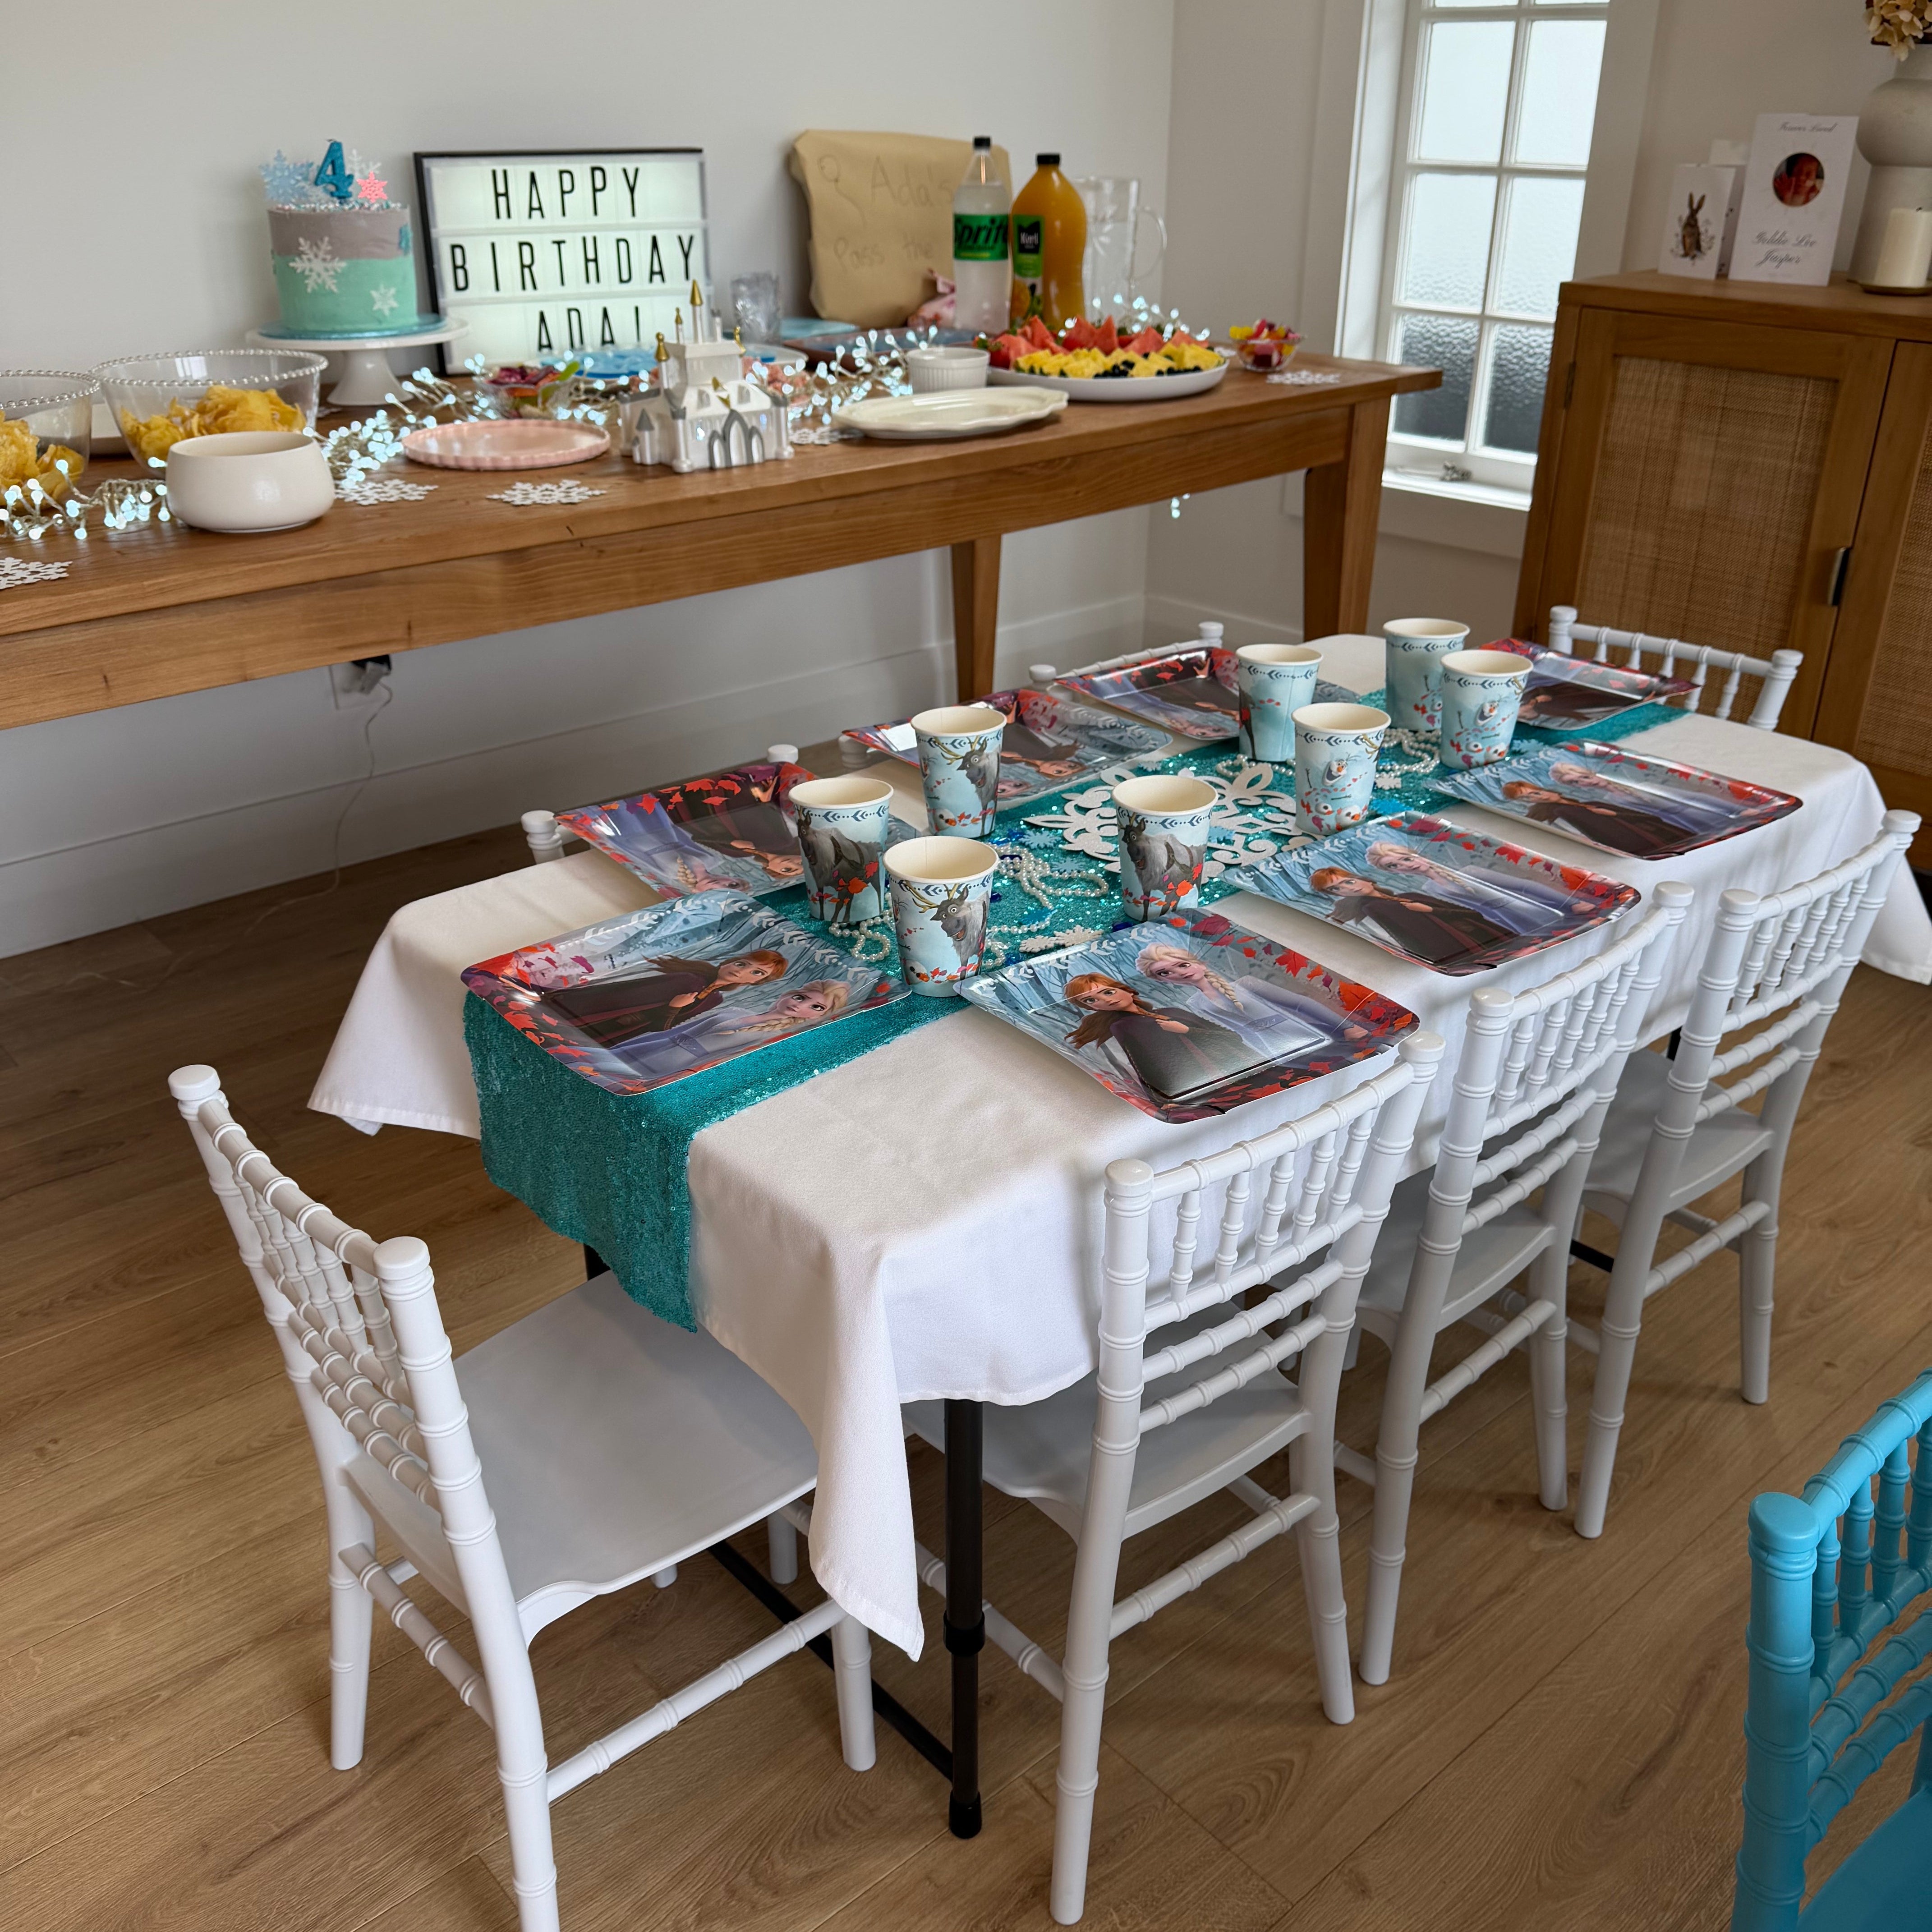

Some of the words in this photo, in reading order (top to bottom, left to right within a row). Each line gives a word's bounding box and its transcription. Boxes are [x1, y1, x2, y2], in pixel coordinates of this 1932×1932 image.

[315, 141, 354, 198] 4
[491, 166, 640, 220] HAPPY
[450, 234, 695, 292] BIRTHDAY
